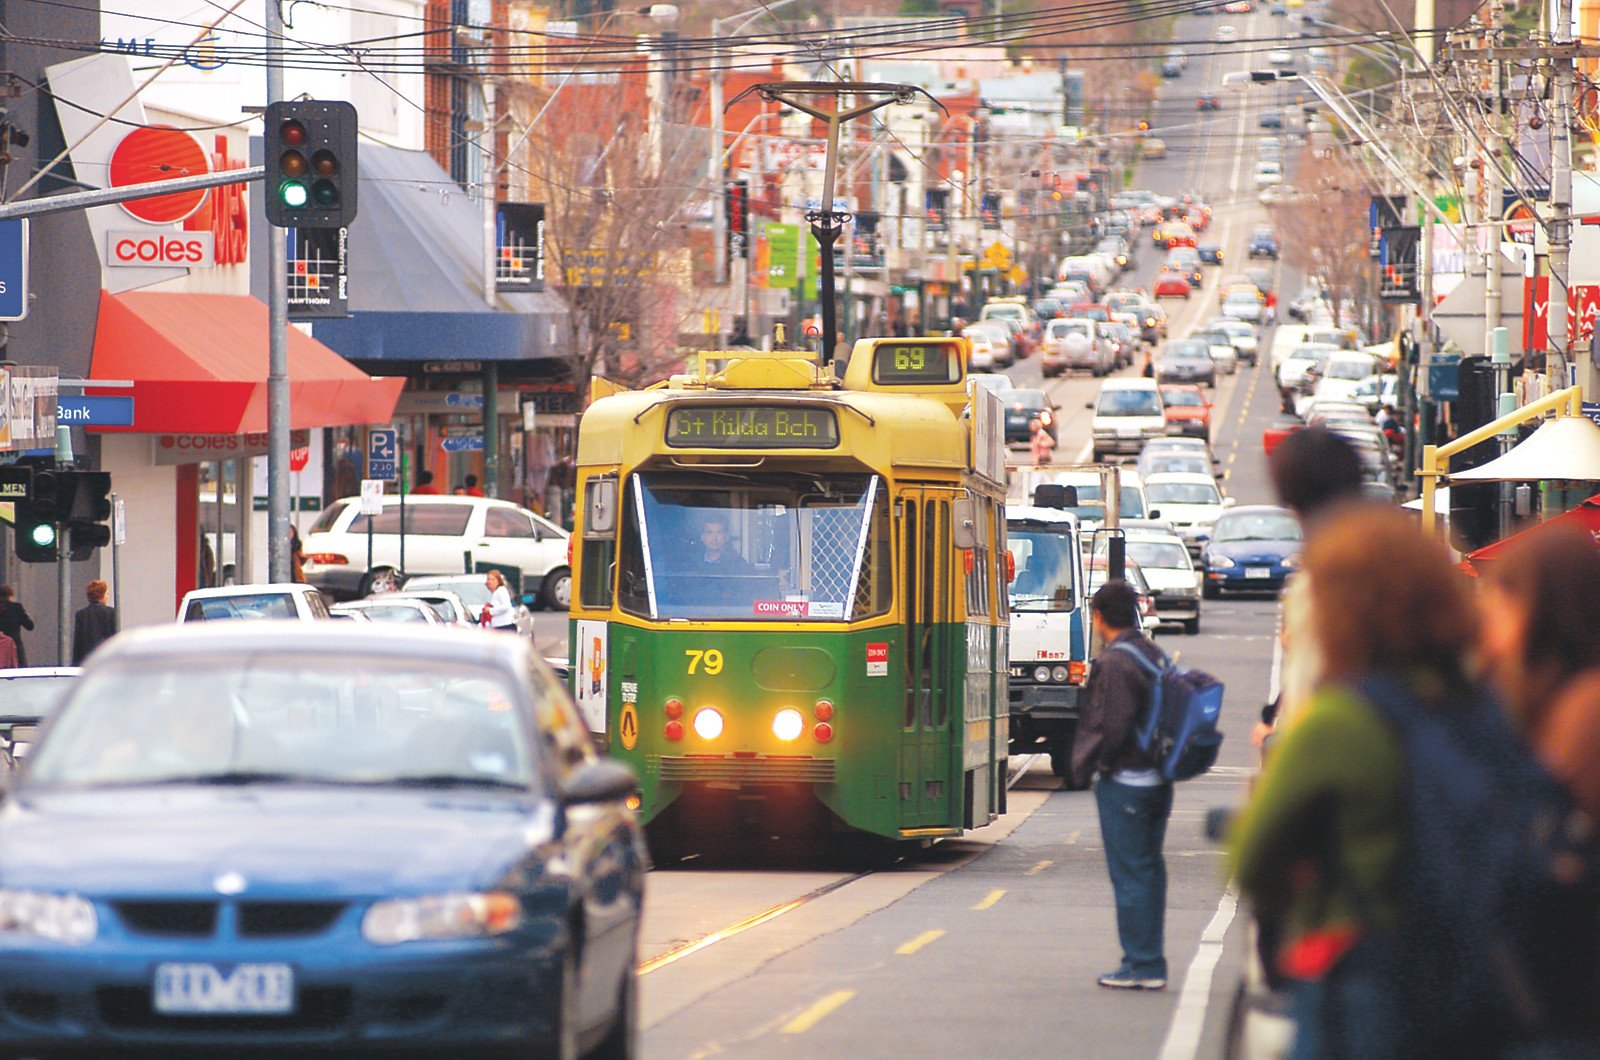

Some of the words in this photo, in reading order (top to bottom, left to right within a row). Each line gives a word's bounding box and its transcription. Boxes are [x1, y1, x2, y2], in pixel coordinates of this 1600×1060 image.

[115, 235, 203, 262] coles
[338, 275, 348, 299] Road
[895, 347, 925, 370] 69
[57, 405, 91, 420] Bank
[678, 410, 705, 435] St
[713, 411, 768, 436] Kilda
[775, 411, 817, 436] Bch
[3, 484, 26, 494] MEN
[758, 603, 781, 611] COIN
[781, 603, 805, 612] ONLY
[685, 649, 723, 675] 79
